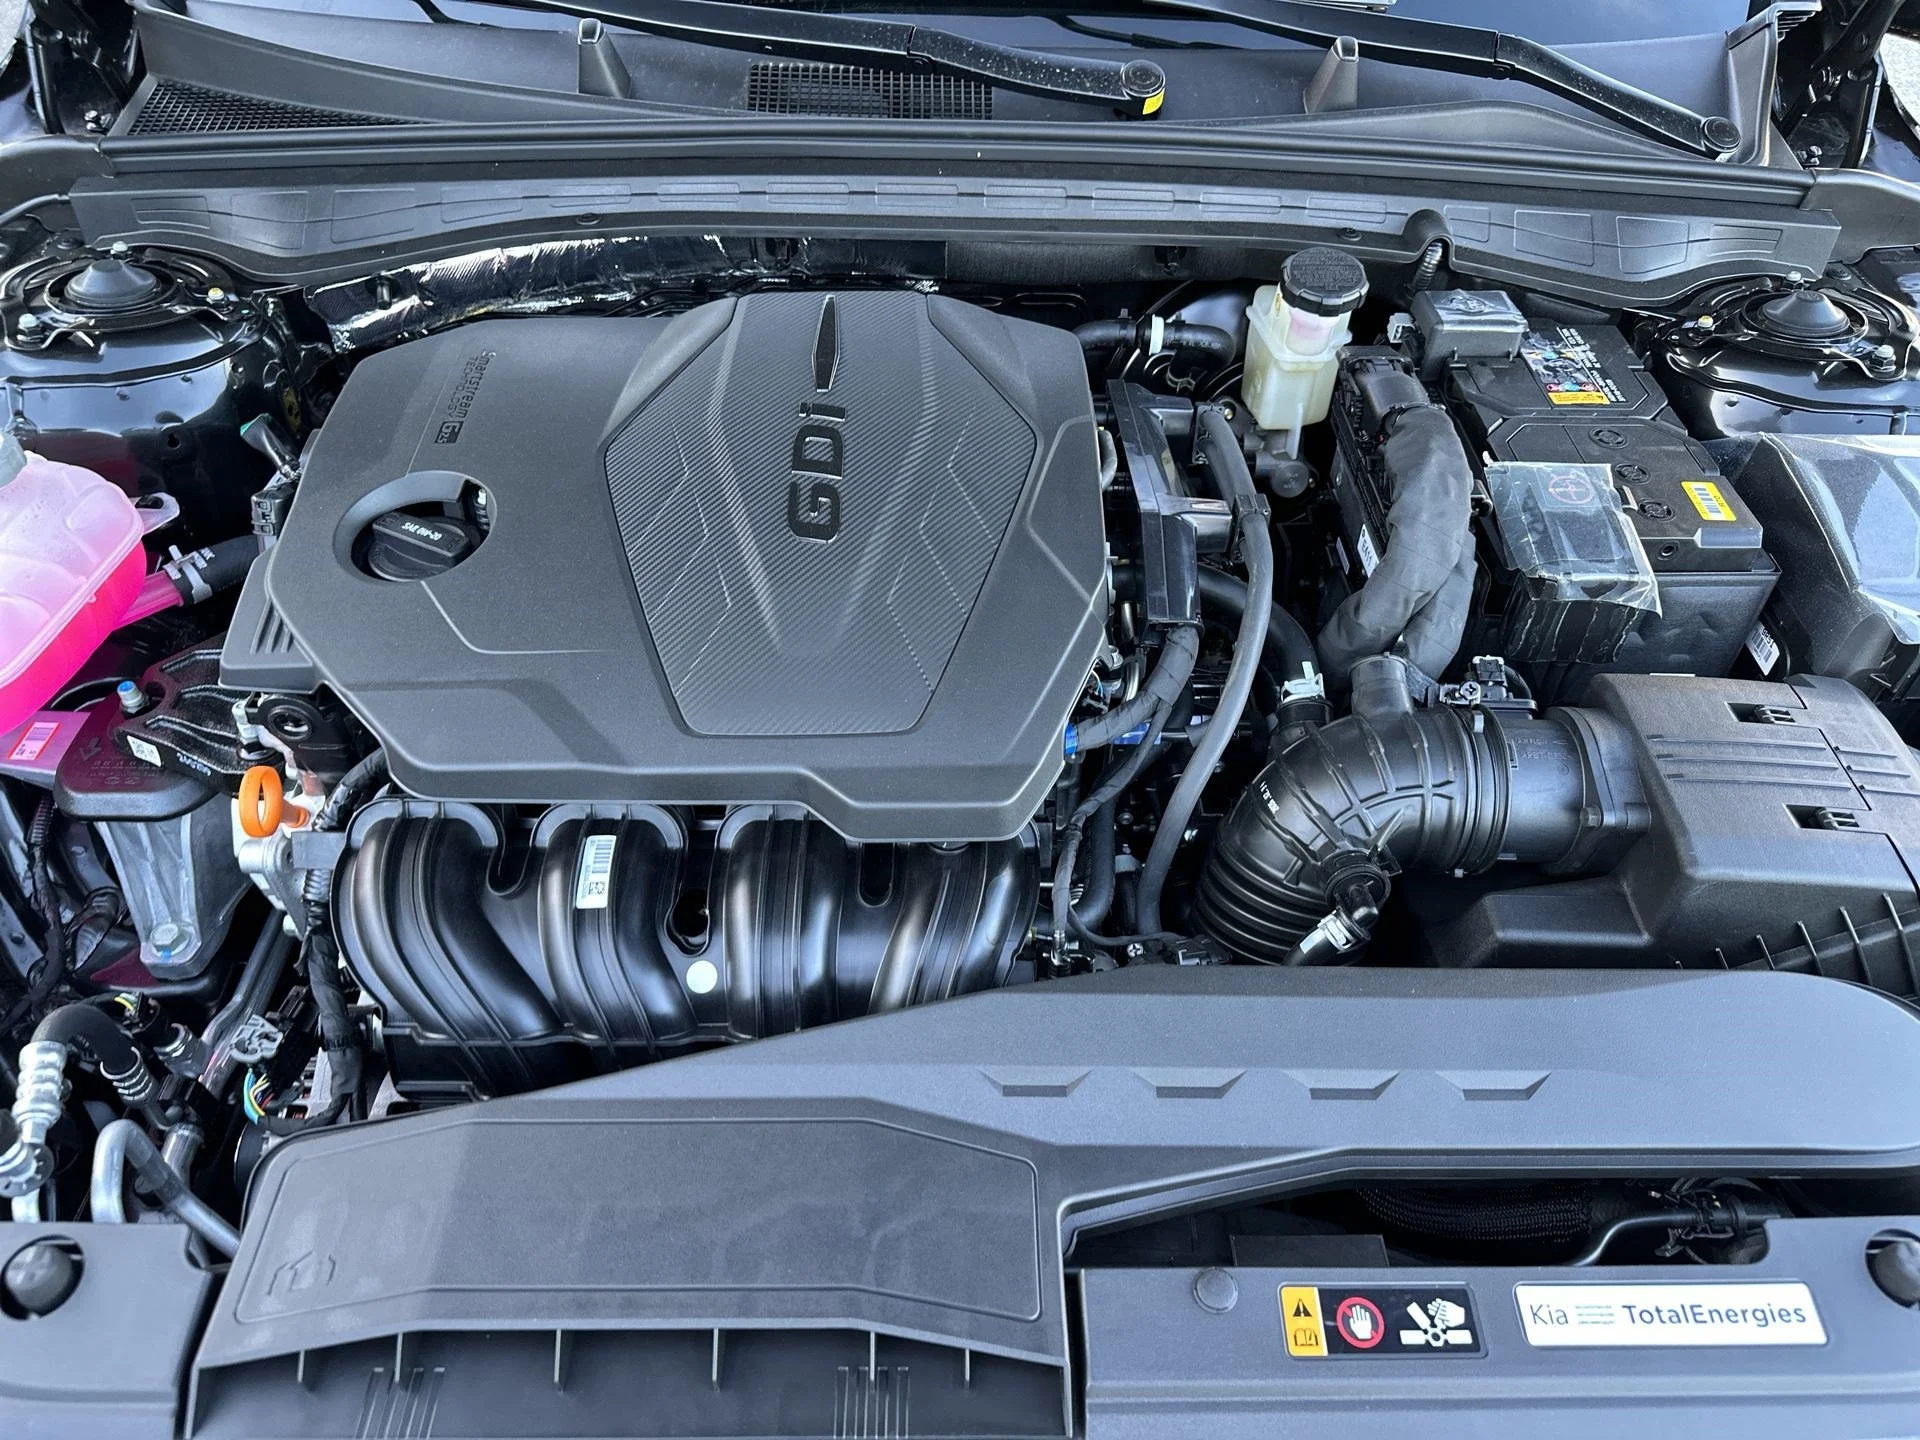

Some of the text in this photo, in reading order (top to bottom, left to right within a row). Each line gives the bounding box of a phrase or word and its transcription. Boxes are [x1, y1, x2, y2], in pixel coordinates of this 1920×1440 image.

[455, 350, 496, 419] Smartstream
[787, 401, 846, 544] GDi
[1530, 1302, 1808, 1328] Kia TotalEnergies
